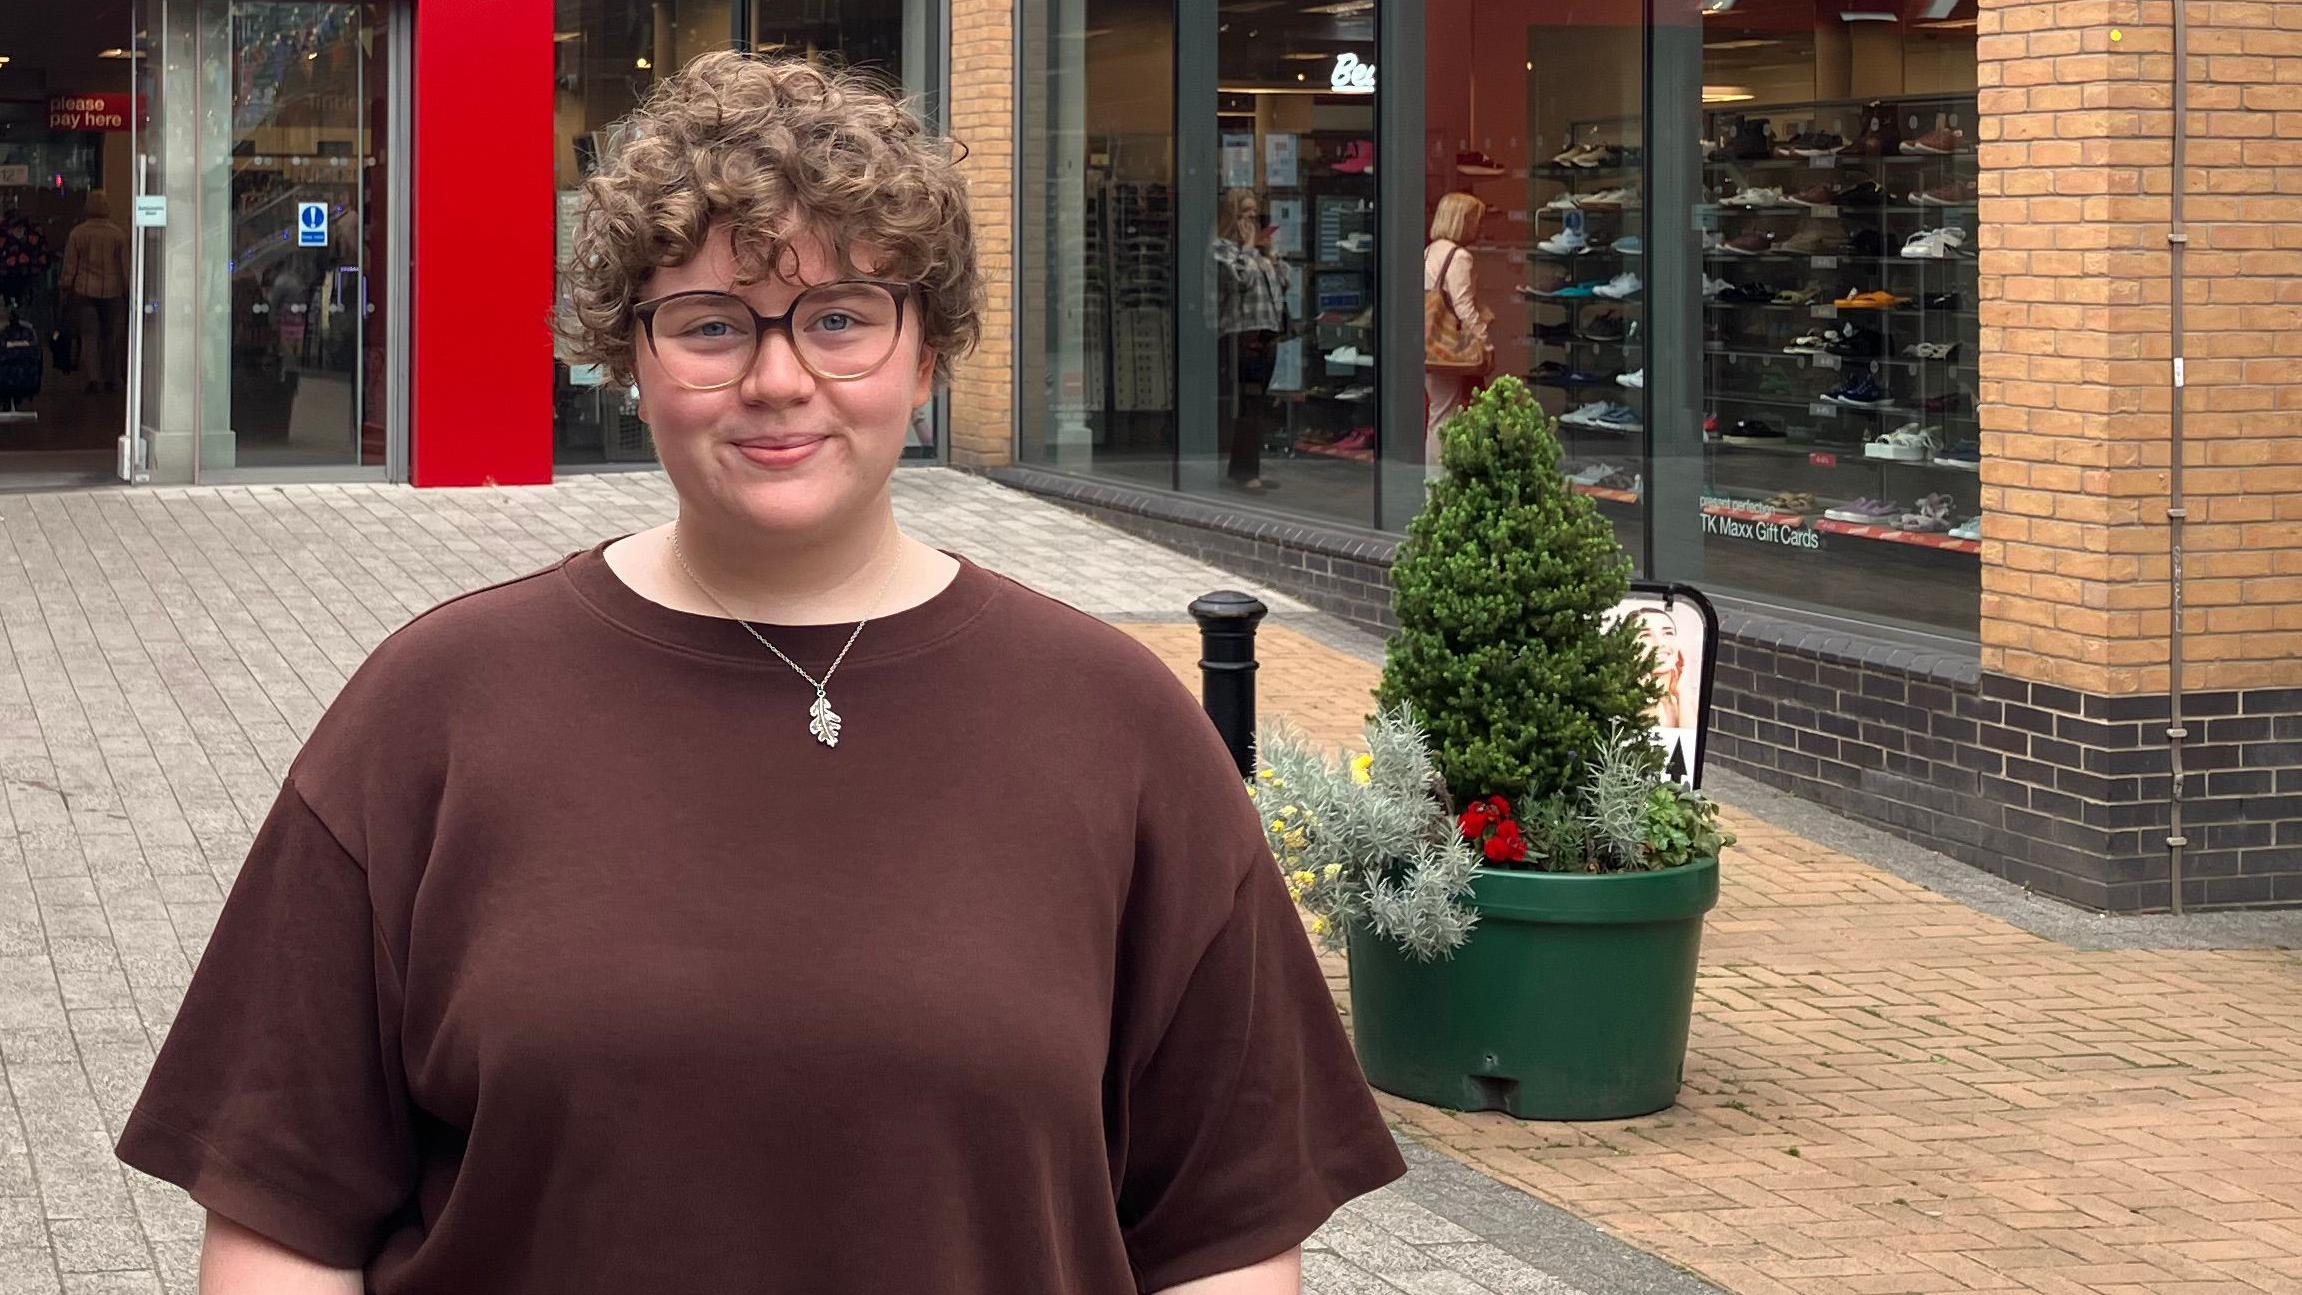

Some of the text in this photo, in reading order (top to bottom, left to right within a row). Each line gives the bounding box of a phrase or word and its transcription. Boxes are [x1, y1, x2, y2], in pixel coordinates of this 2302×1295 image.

[50, 96, 104, 112] please
[50, 111, 122, 130] pay here
[1732, 499, 1776, 516] perfection
[1700, 513, 1819, 549] TK Maxx Gift Cards
